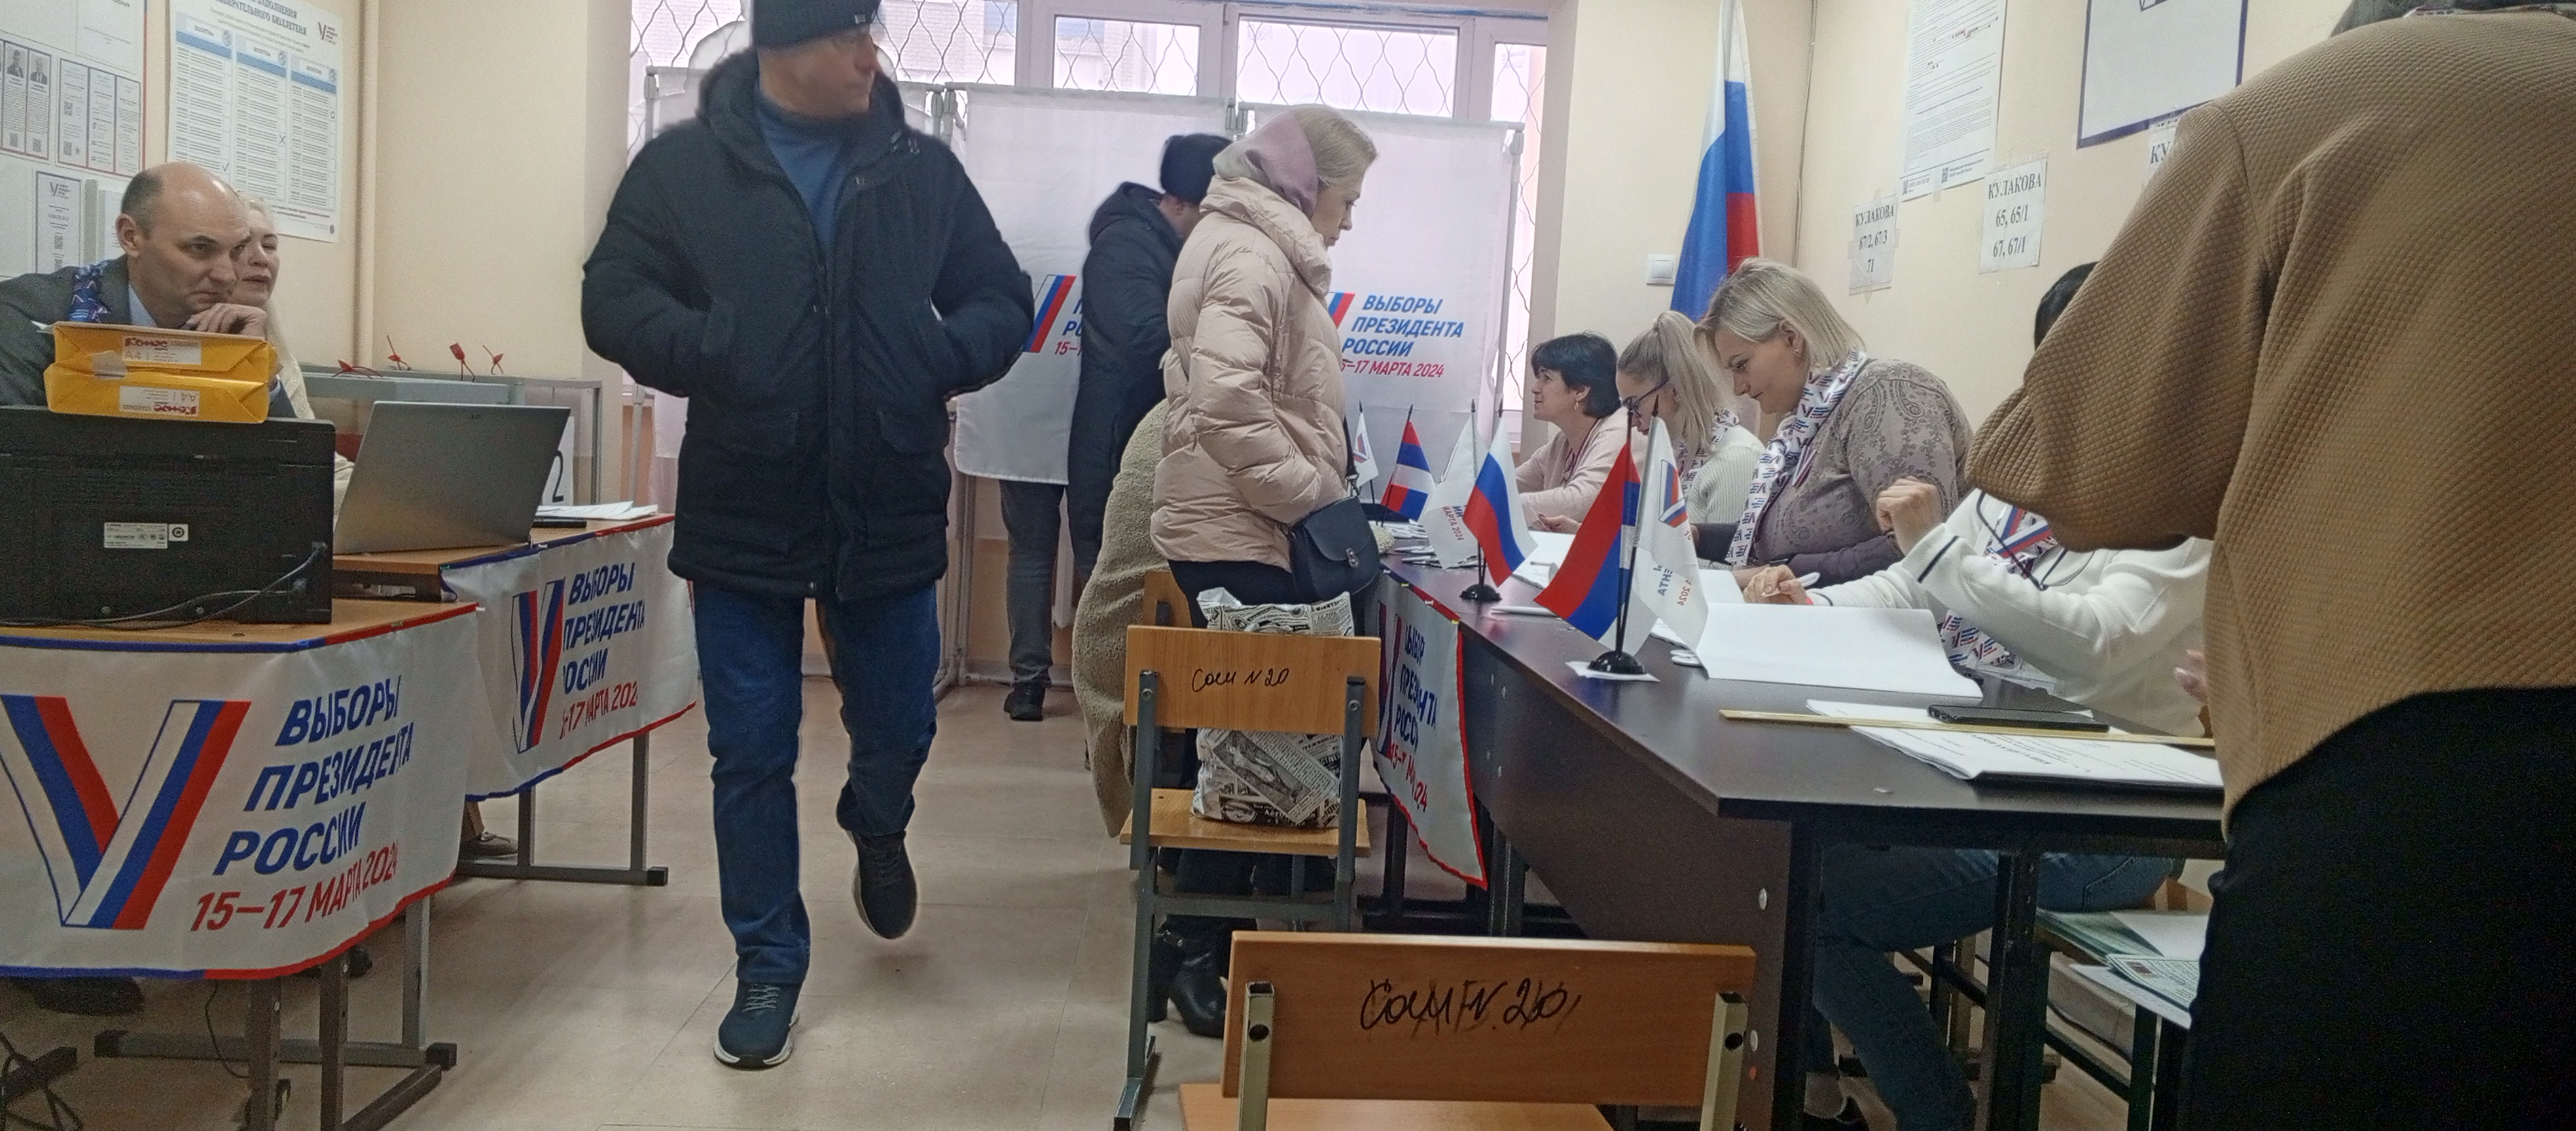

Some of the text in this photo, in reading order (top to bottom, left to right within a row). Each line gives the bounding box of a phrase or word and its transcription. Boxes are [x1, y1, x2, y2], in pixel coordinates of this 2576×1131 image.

[1988, 173, 2041, 200] КУЛАКОВА
[1855, 204, 1894, 227] КУЛАКОВА
[1996, 204, 2028, 228] 65, 65/1
[1993, 236, 2026, 259] 67, 67/1
[1867, 259, 1874, 273] 71
[1363, 295, 1443, 314] ВЫБОРЫ
[1351, 316, 1464, 338] ПРЕЗИДЕНТА
[1342, 338, 1414, 357] РОССИИ
[1341, 359, 1444, 378] 5–17 МАРТА 2024
[1264, 668, 1289, 687] 20
[611, 680, 638, 711] 202
[275, 675, 401, 746] ВЫБОРЫ
[243, 722, 414, 812] ПРЕЗИДЕНТА
[213, 802, 366, 875] РОССИИ
[190, 886, 306, 931] 15–17
[306, 859, 362, 922] МАРТА
